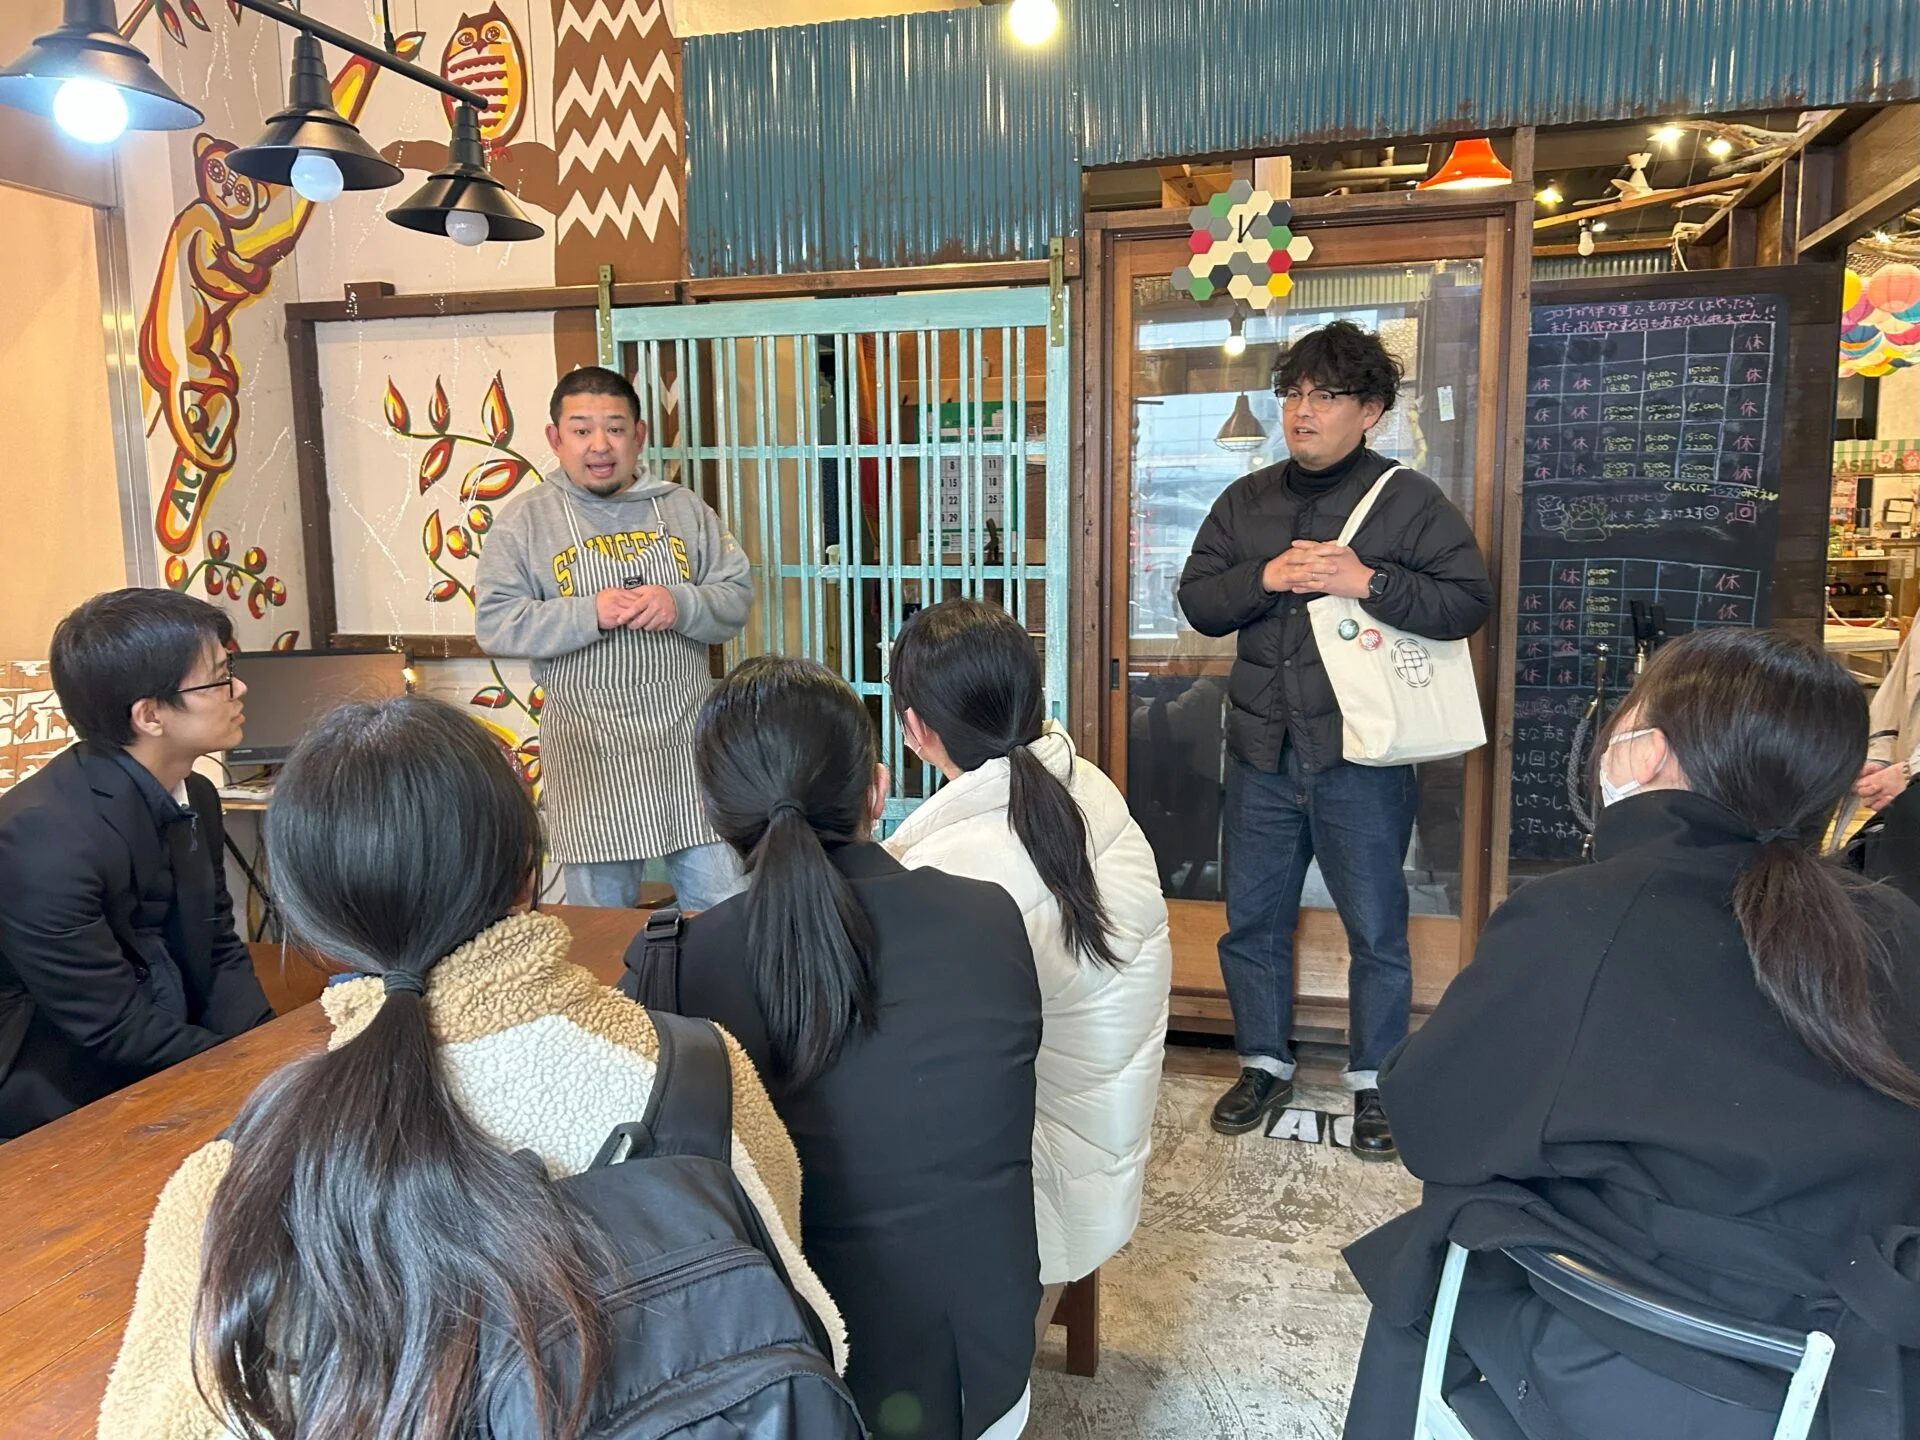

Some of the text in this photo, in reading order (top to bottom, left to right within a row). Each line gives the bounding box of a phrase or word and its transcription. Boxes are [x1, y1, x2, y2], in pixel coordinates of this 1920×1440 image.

[1745, 334, 1764, 350] 休
[1534, 378, 1551, 391] 休
[1573, 377, 1592, 391] 休
[1746, 368, 1762, 382] 休
[1535, 408, 1550, 422] 休
[1571, 405, 1589, 419] 休
[1740, 400, 1758, 417] 休
[1534, 436, 1551, 450] 休
[1572, 437, 1589, 450] 休
[1732, 435, 1756, 451] 休
[950, 459, 997, 470] 8 11
[1535, 466, 1550, 480] 休
[1570, 462, 1587, 475] 休
[1732, 465, 1753, 481] 休
[949, 477, 997, 488] 15 18
[949, 494, 997, 505] 22 25
[949, 513, 958, 523] 29
[1560, 568, 1581, 584] 休
[1716, 573, 1741, 591] 休
[1523, 594, 1543, 610] 休
[1559, 597, 1577, 611] 休
[1717, 603, 1739, 620] 休
[1524, 620, 1543, 633] 休
[1559, 618, 1577, 631] 休
[1526, 642, 1543, 655] 休
[1523, 668, 1573, 684] 休 休
